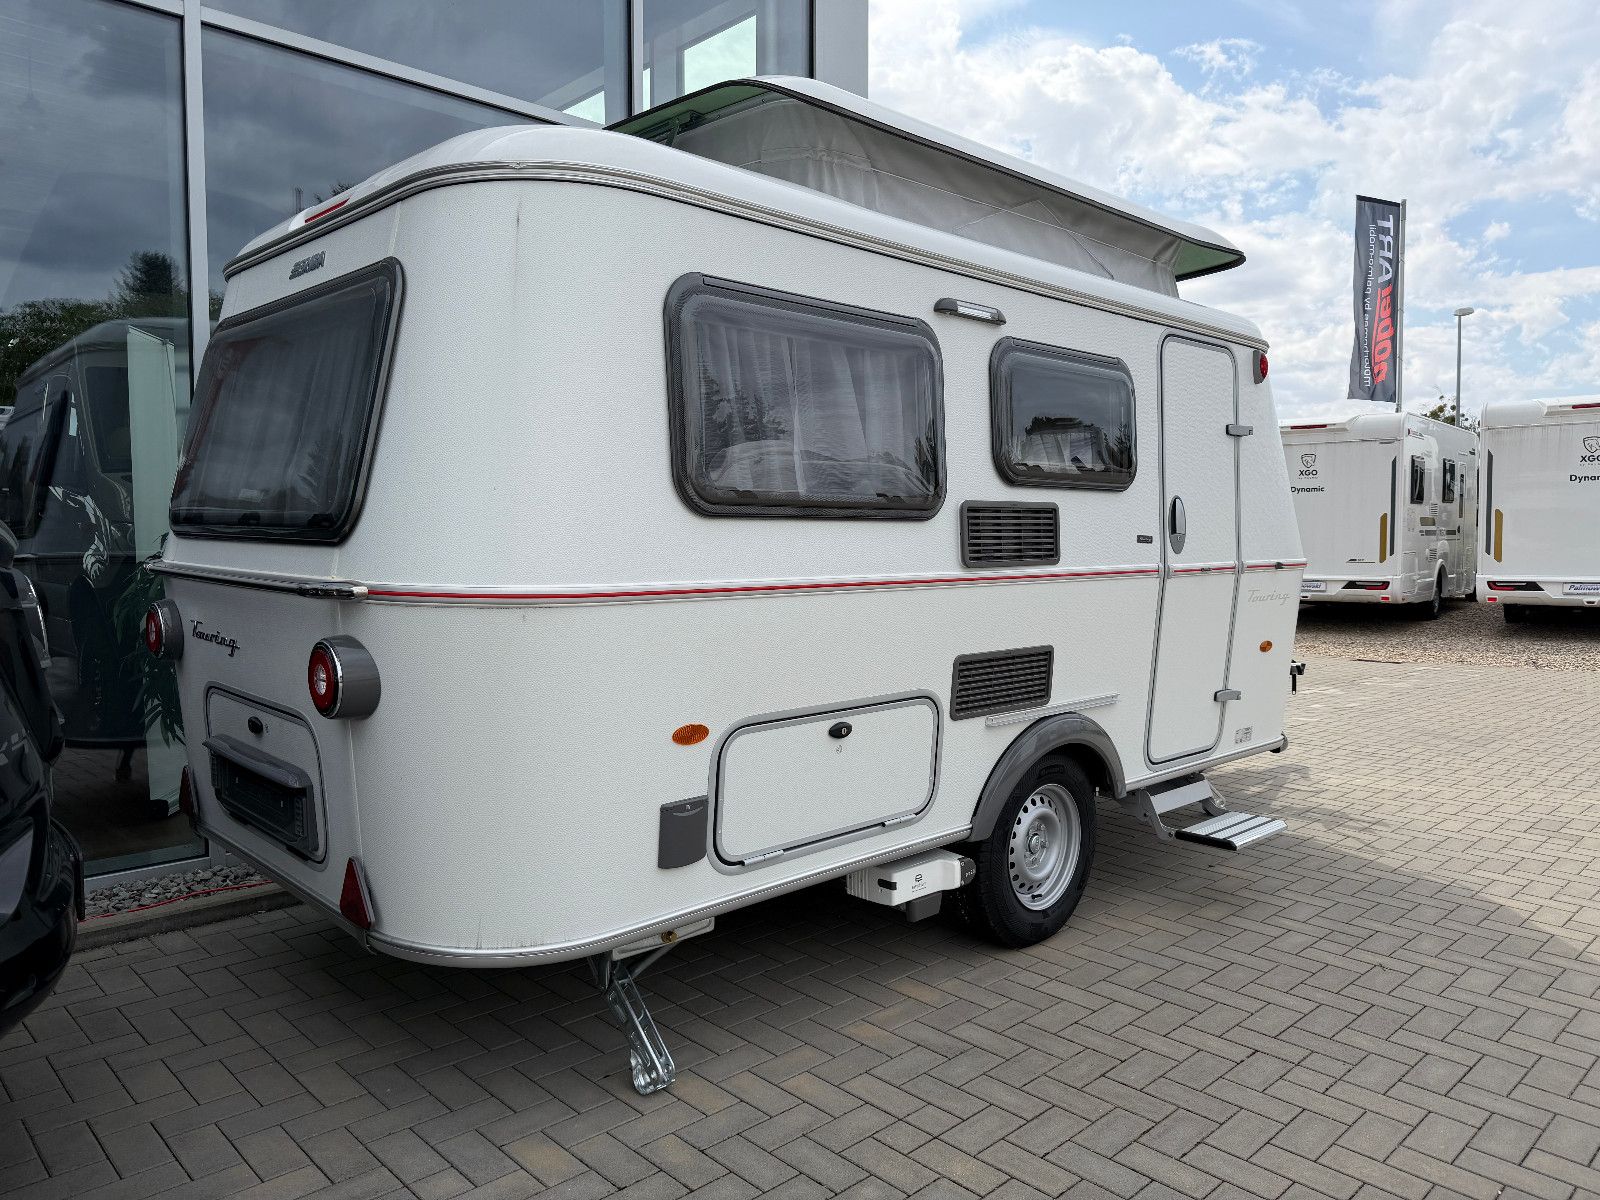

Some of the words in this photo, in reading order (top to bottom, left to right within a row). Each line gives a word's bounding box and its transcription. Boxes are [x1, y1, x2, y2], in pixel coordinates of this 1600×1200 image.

[1298, 469, 1318, 477] XGO
[1291, 485, 1325, 495] Dynamic
[1247, 589, 1291, 606] Touring
[190, 619, 240, 657] Touring
